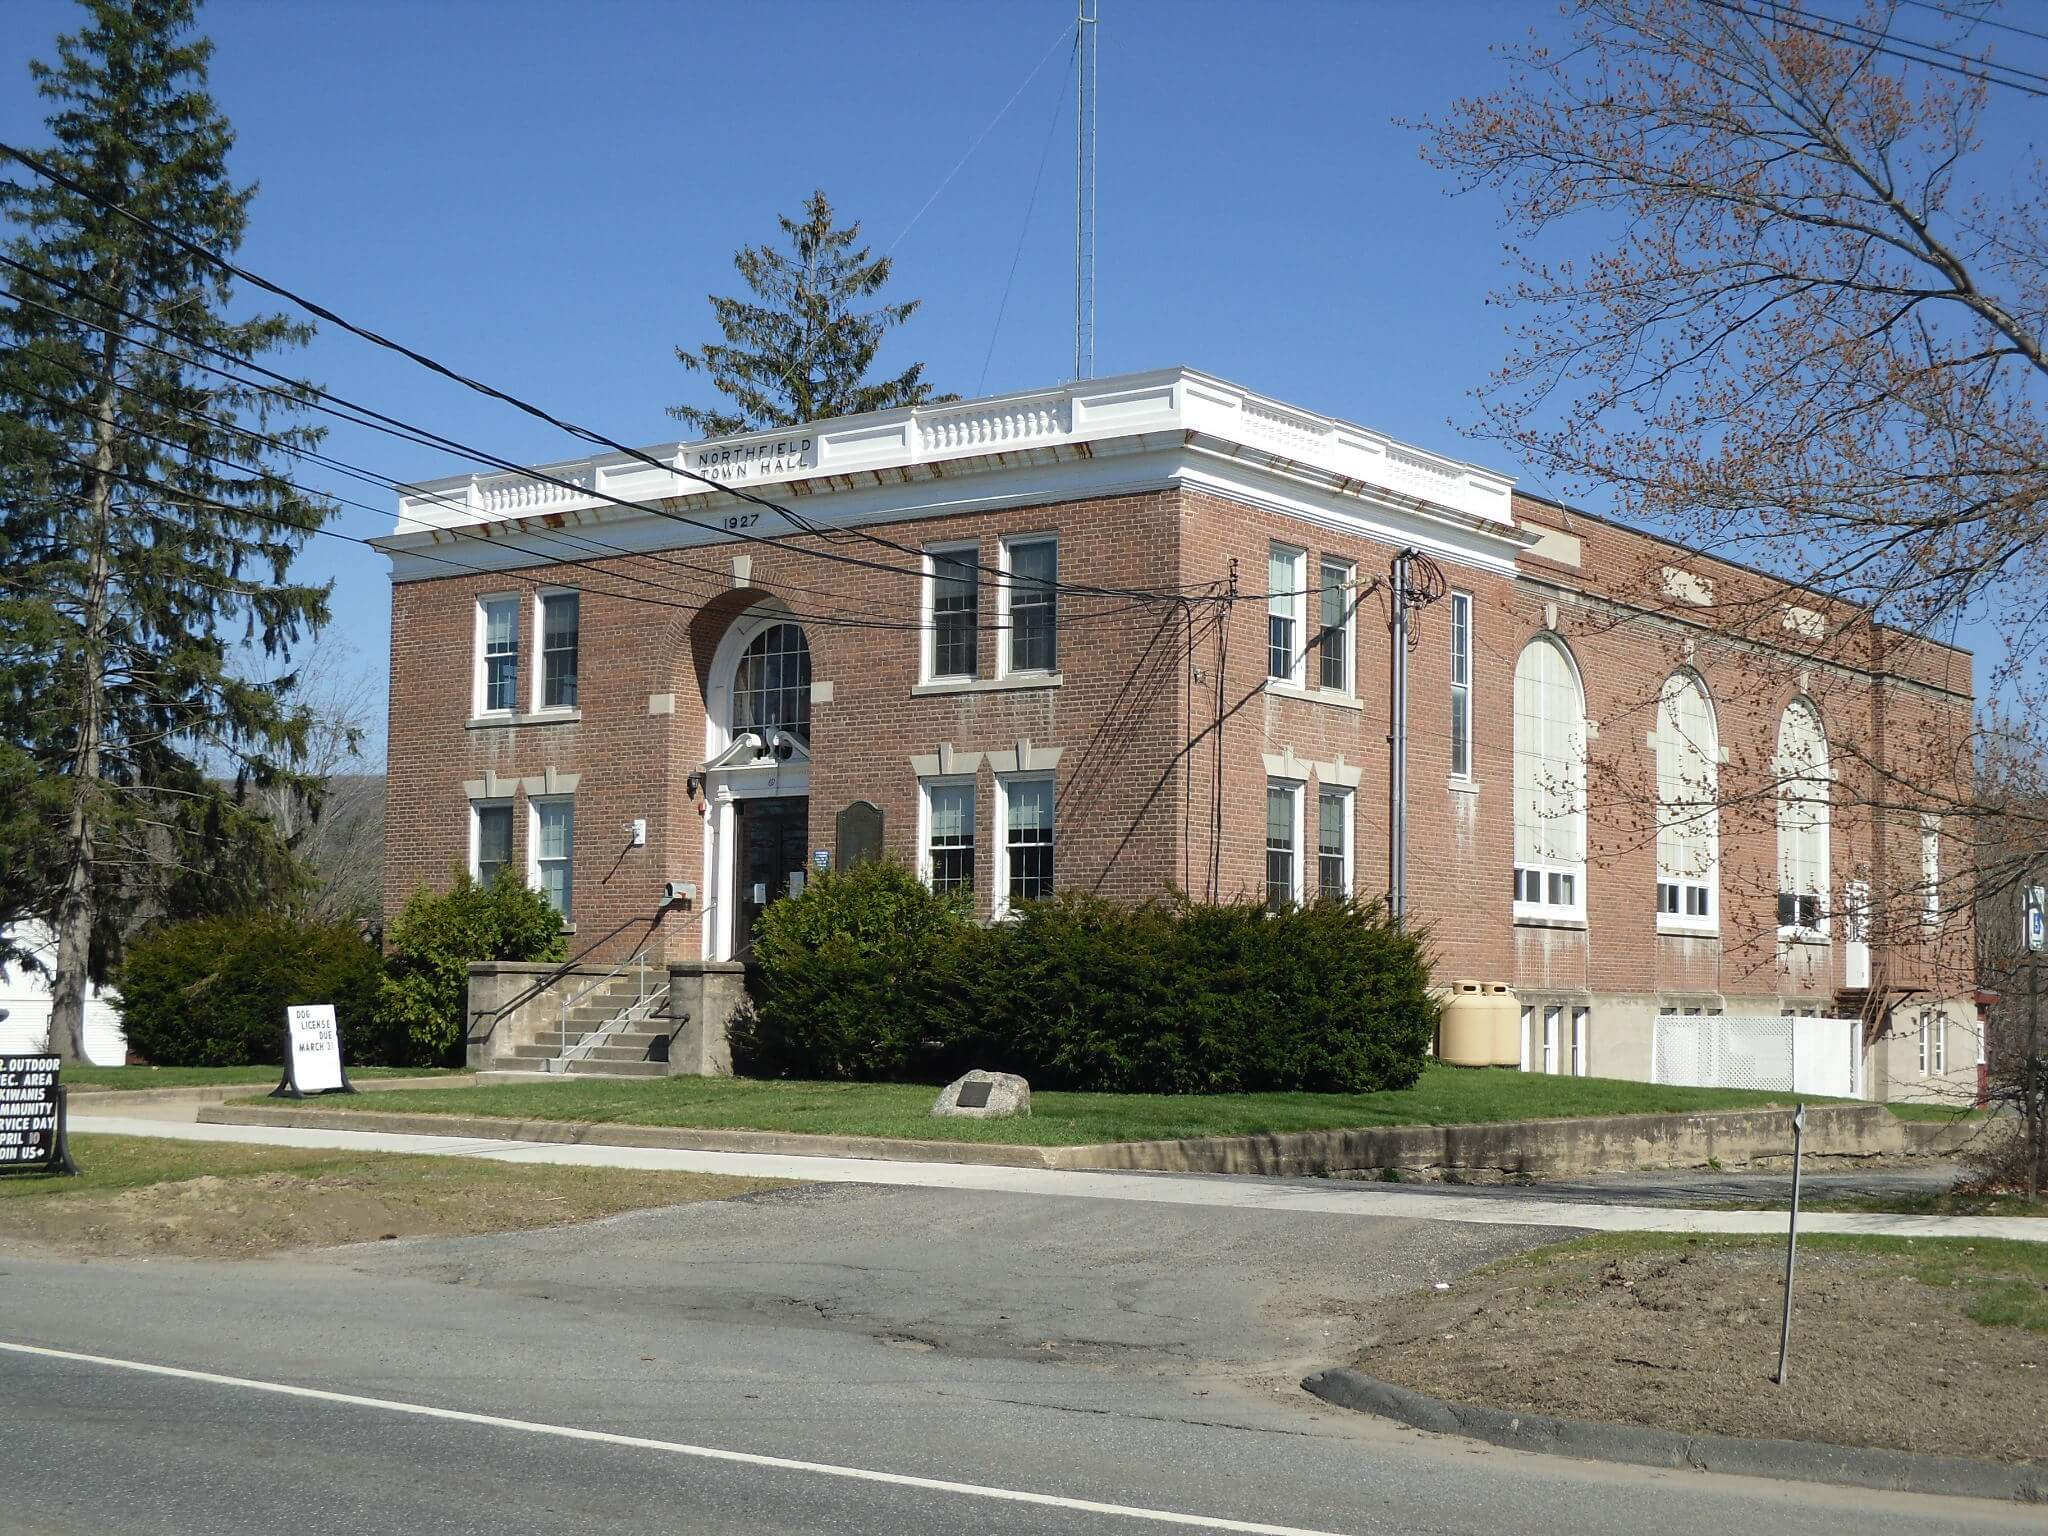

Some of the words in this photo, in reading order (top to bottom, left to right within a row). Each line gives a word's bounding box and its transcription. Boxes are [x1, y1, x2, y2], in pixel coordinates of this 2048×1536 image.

[699, 439, 811, 465] NORTHFIELD
[701, 463, 747, 480] TOWN
[761, 456, 808, 474] HALL
[724, 514, 759, 529] 1927
[301, 1020, 330, 1030] LICENSE
[319, 1031, 332, 1040] DUE
[299, 1042, 324, 1052] MARCH
[9, 1058, 60, 1072] OUTDOOR
[0, 1073, 18, 1086] EC.
[24, 1073, 53, 1086] AREA
[0, 1088, 45, 1101] KIWANIS
[0, 1102, 53, 1116] MMUNITY
[33, 1117, 55, 1130] DAY
[0, 1132, 23, 1145] PRIL
[22, 1146, 36, 1159] US
